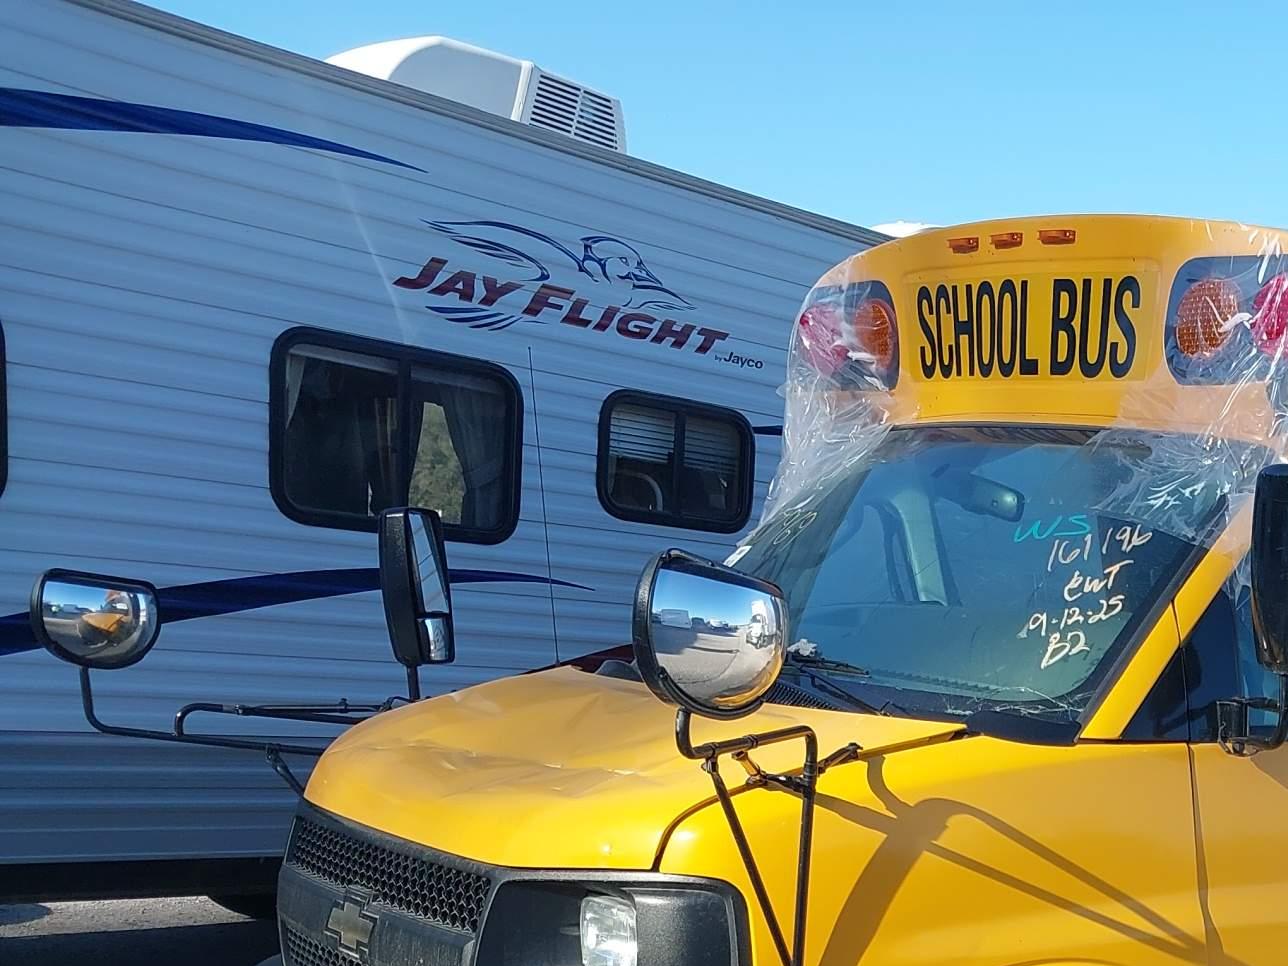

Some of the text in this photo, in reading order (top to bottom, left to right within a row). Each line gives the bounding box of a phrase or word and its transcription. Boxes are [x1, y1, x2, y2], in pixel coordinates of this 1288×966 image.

[392, 257, 730, 355] JAY FLIGHT
[917, 276, 1140, 379] SCHOOL BUS
[723, 351, 764, 369] Jayco
